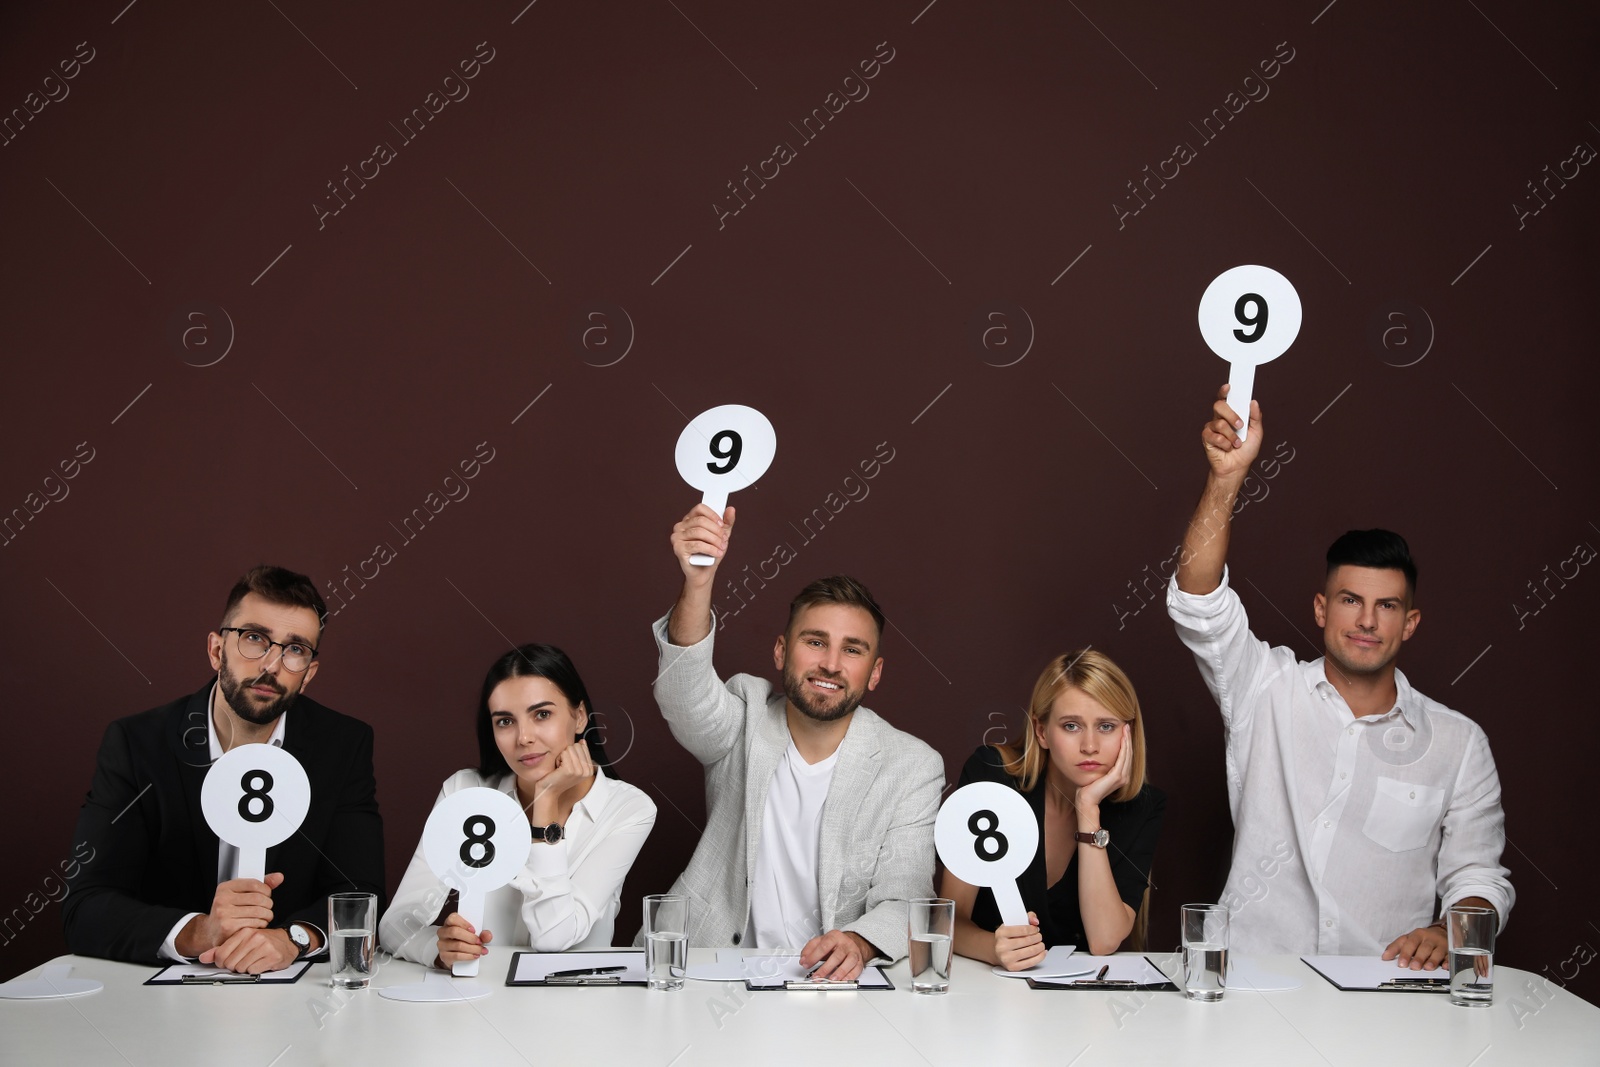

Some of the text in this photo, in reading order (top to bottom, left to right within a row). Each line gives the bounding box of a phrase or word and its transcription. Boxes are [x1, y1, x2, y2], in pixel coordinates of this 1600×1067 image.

[1233, 293, 1268, 343] 9
[707, 430, 742, 474] 9
[238, 770, 274, 822] 8
[460, 815, 495, 868] 8
[968, 810, 1008, 861] 8
